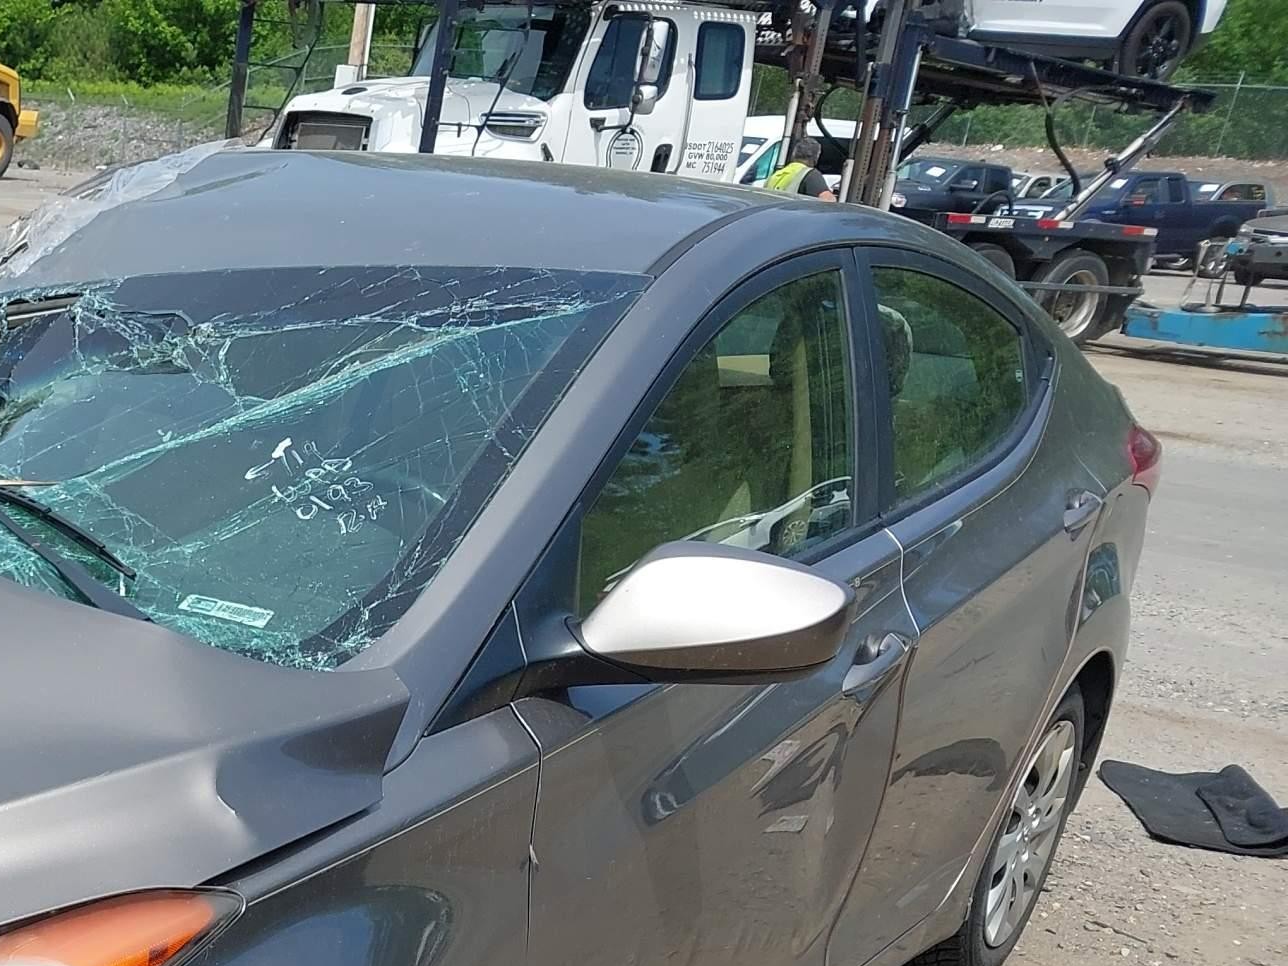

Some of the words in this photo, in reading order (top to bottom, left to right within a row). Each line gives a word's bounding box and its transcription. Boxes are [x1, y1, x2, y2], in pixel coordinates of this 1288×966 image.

[707, 141, 735, 154] 2164025
[688, 152, 704, 160] GVW
[705, 153, 728, 161] 80,000
[702, 161, 726, 174] 751944
[295, 477, 373, 520] 0193
